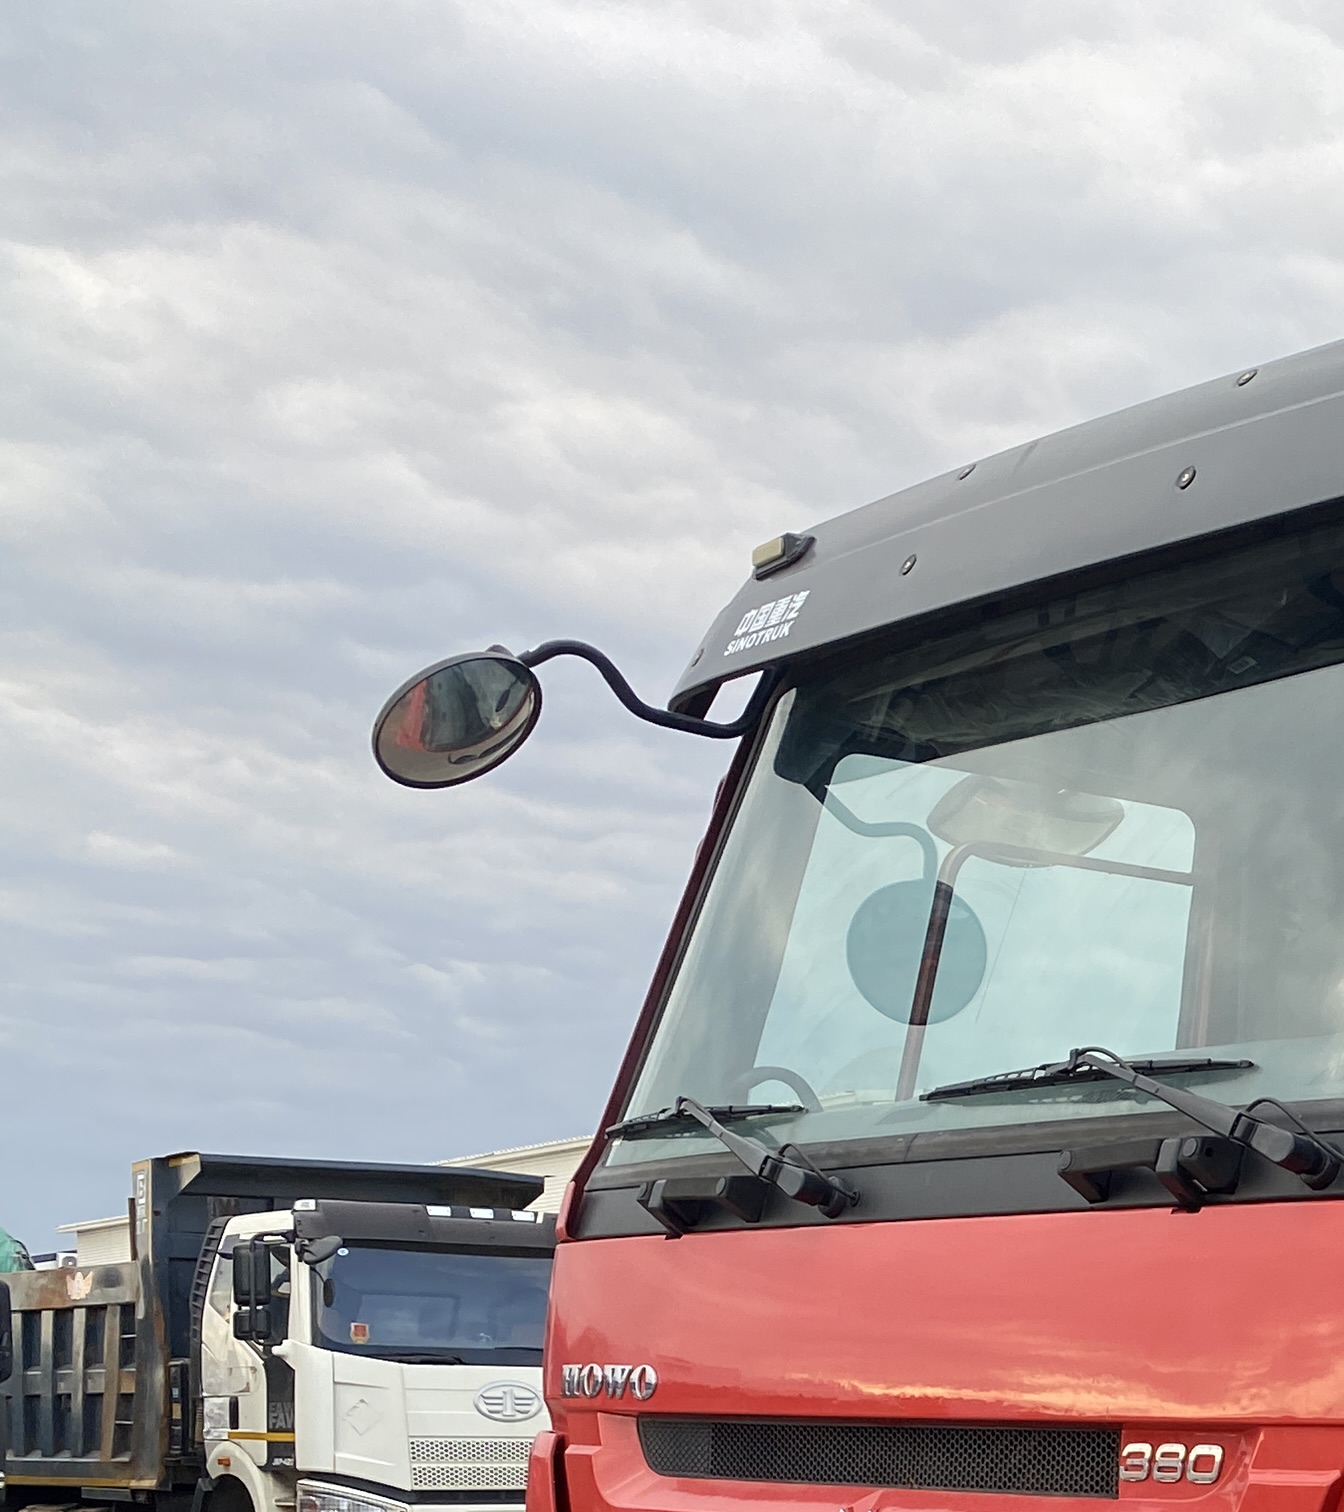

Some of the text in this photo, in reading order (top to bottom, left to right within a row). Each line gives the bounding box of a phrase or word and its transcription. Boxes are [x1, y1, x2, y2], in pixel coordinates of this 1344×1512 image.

[734, 590, 810, 637] 中国重汽
[724, 620, 795, 656] SINOTRUK
[562, 1363, 658, 1400] HOWO
[1119, 1443, 1223, 1484] 380
